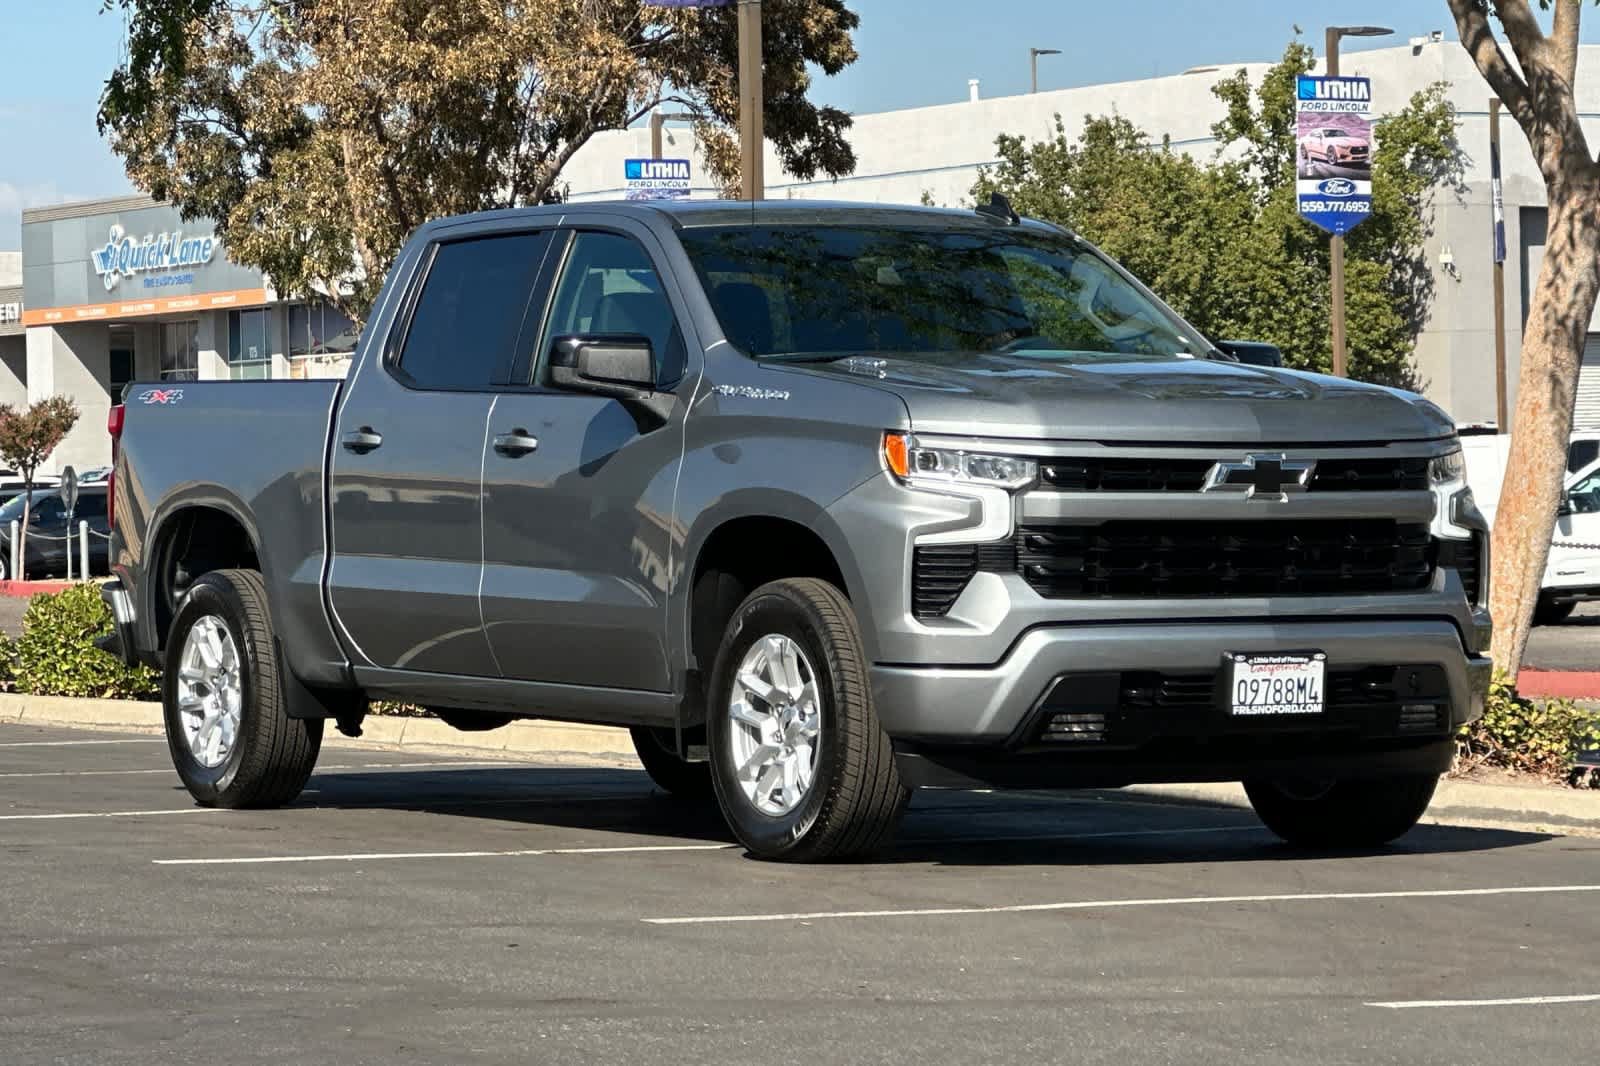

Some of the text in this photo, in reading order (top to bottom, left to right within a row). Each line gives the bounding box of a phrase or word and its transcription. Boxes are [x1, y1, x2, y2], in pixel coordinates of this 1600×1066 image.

[1315, 80, 1369, 99] LITHIA
[1300, 102, 1369, 112] FORD LINCOLN
[641, 162, 689, 178] LITHIA
[628, 180, 689, 188] FORD LINCOLN
[1325, 180, 1351, 194] Ford
[1301, 200, 1370, 213] 559.777.6952
[119, 231, 215, 275] Quick Lane
[1237, 677, 1319, 705] 09788M4
